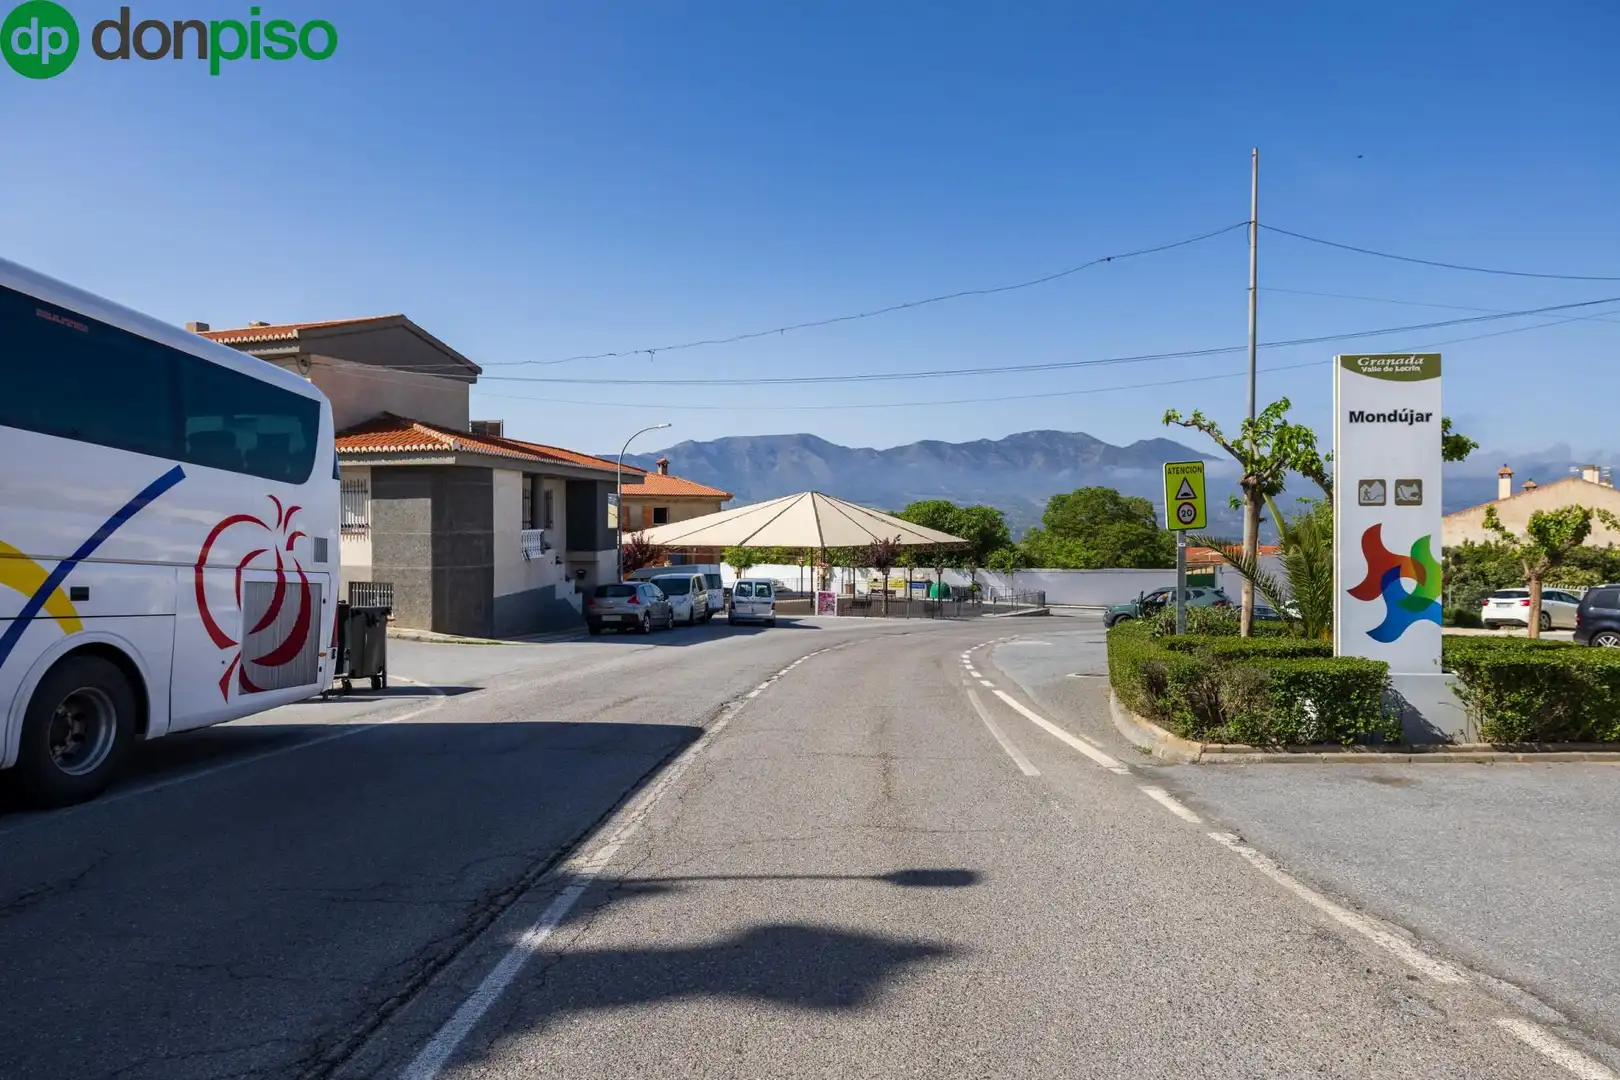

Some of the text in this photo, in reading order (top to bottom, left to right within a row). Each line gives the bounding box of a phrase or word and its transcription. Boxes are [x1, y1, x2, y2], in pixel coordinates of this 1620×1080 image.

[1357, 352, 1424, 366] Granada
[1349, 408, 1433, 426] Mondújar
[1181, 509, 1193, 518] 20
